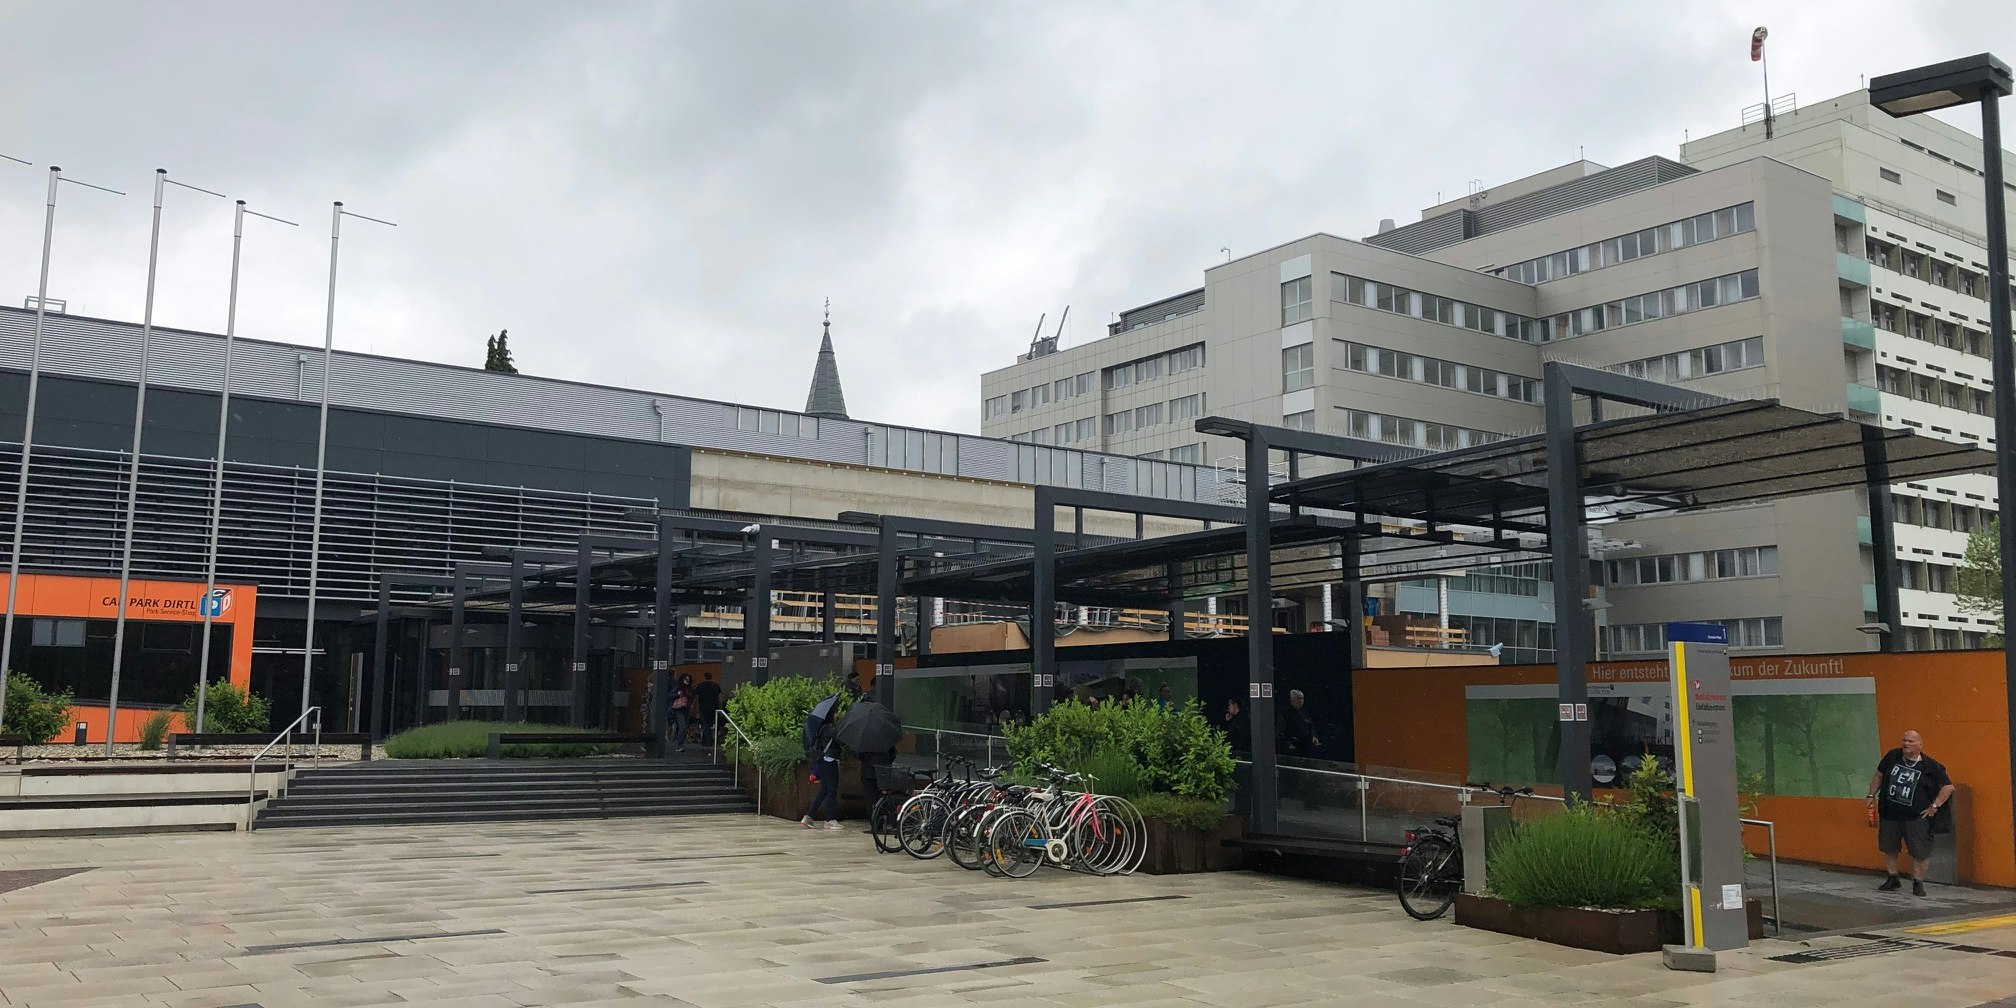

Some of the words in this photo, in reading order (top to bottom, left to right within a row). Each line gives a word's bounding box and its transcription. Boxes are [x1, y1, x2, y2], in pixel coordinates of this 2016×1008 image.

[102, 596, 121, 607] CA
[129, 598, 160, 608] PARK
[163, 599, 196, 610] DIRTL
[1592, 664, 1616, 680] Hier
[1619, 662, 1670, 680] entsteht
[1758, 661, 1781, 676] der
[1783, 658, 1845, 676] Zukunft!
